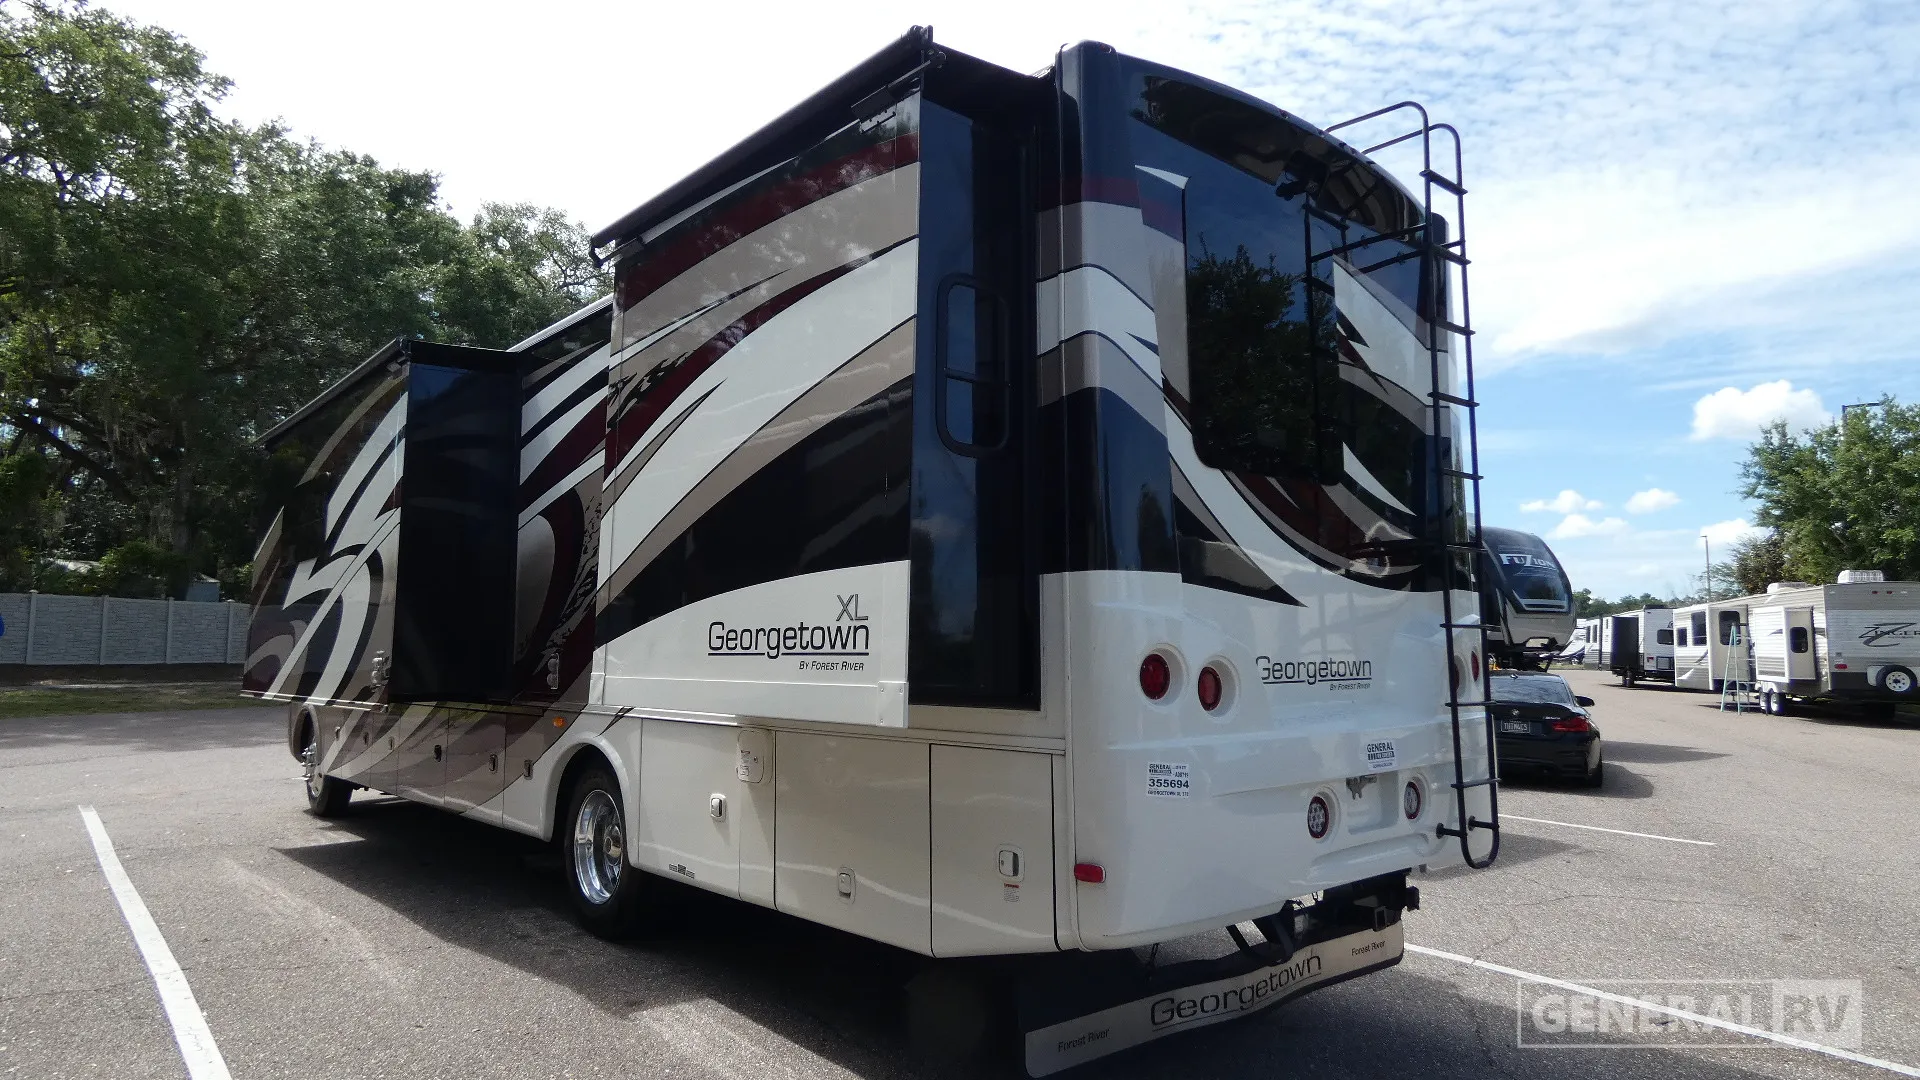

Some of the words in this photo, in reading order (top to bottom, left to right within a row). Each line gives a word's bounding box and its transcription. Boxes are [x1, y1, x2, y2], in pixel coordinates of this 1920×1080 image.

[836, 593, 869, 621] XL
[708, 621, 870, 660] Georgetown
[799, 660, 810, 670] BY
[811, 661, 840, 671] FOREST
[841, 661, 865, 671] RIVER
[1255, 655, 1372, 685] Georgetown
[1337, 683, 1357, 691] FOREST
[1366, 742, 1394, 752] GENERAL
[1148, 779, 1189, 788] 355694
[1351, 943, 1371, 957] Forest
[1371, 939, 1386, 952] River
[1151, 955, 1322, 1026] Georgetown
[1057, 1035, 1087, 1052] Forest
[1087, 1028, 1109, 1043] River
